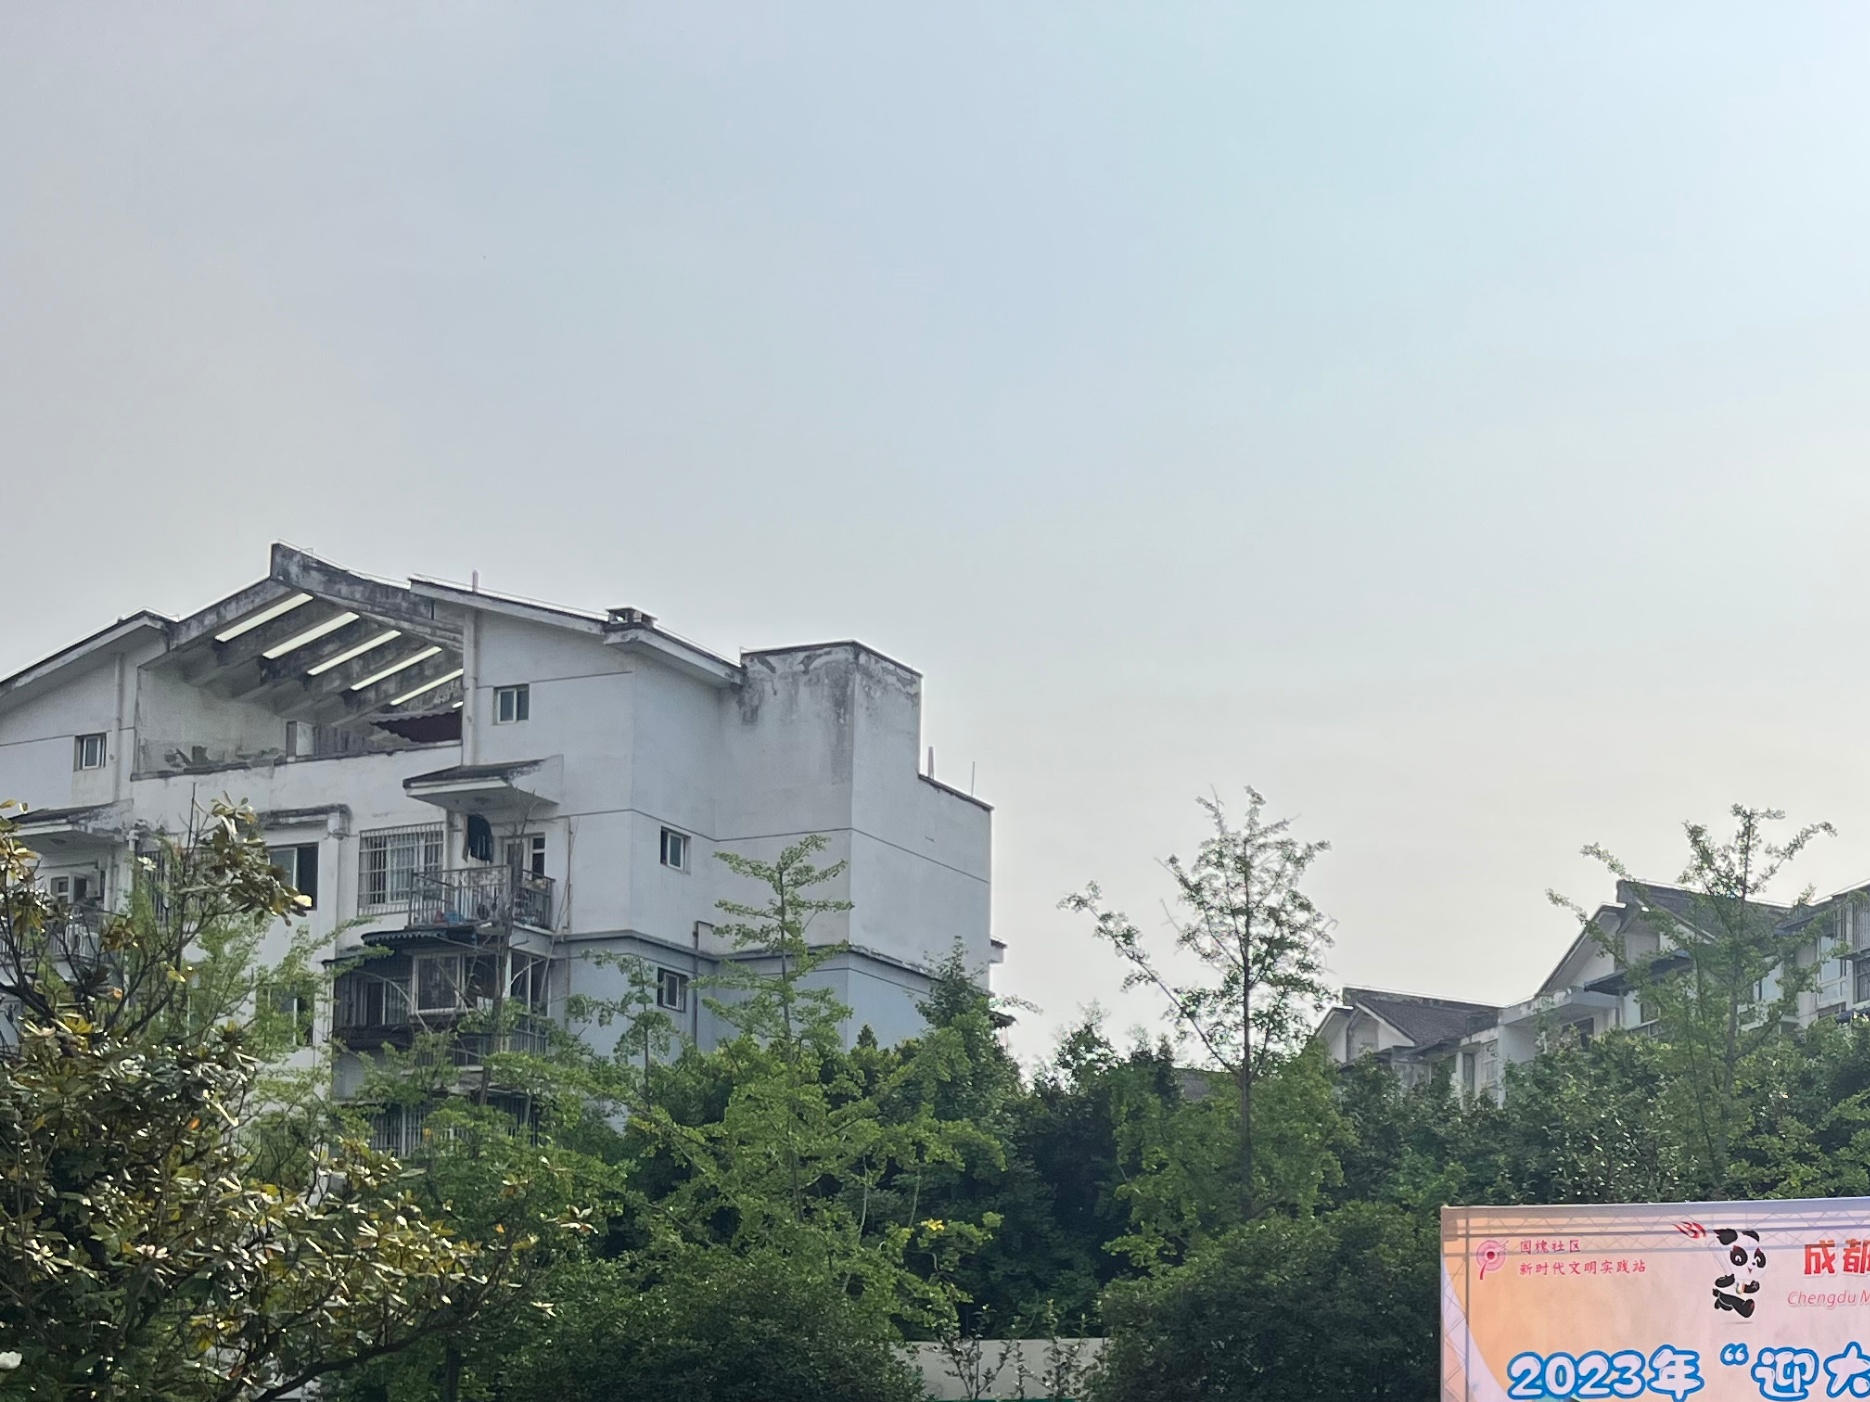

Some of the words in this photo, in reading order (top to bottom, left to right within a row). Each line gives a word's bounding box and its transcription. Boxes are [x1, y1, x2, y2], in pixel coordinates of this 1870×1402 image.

[1519, 1239, 1582, 1254] 国槐社区
[1519, 1258, 1646, 1276] 新时代文明实践站
[1787, 1290, 1856, 1309] Chengdu
